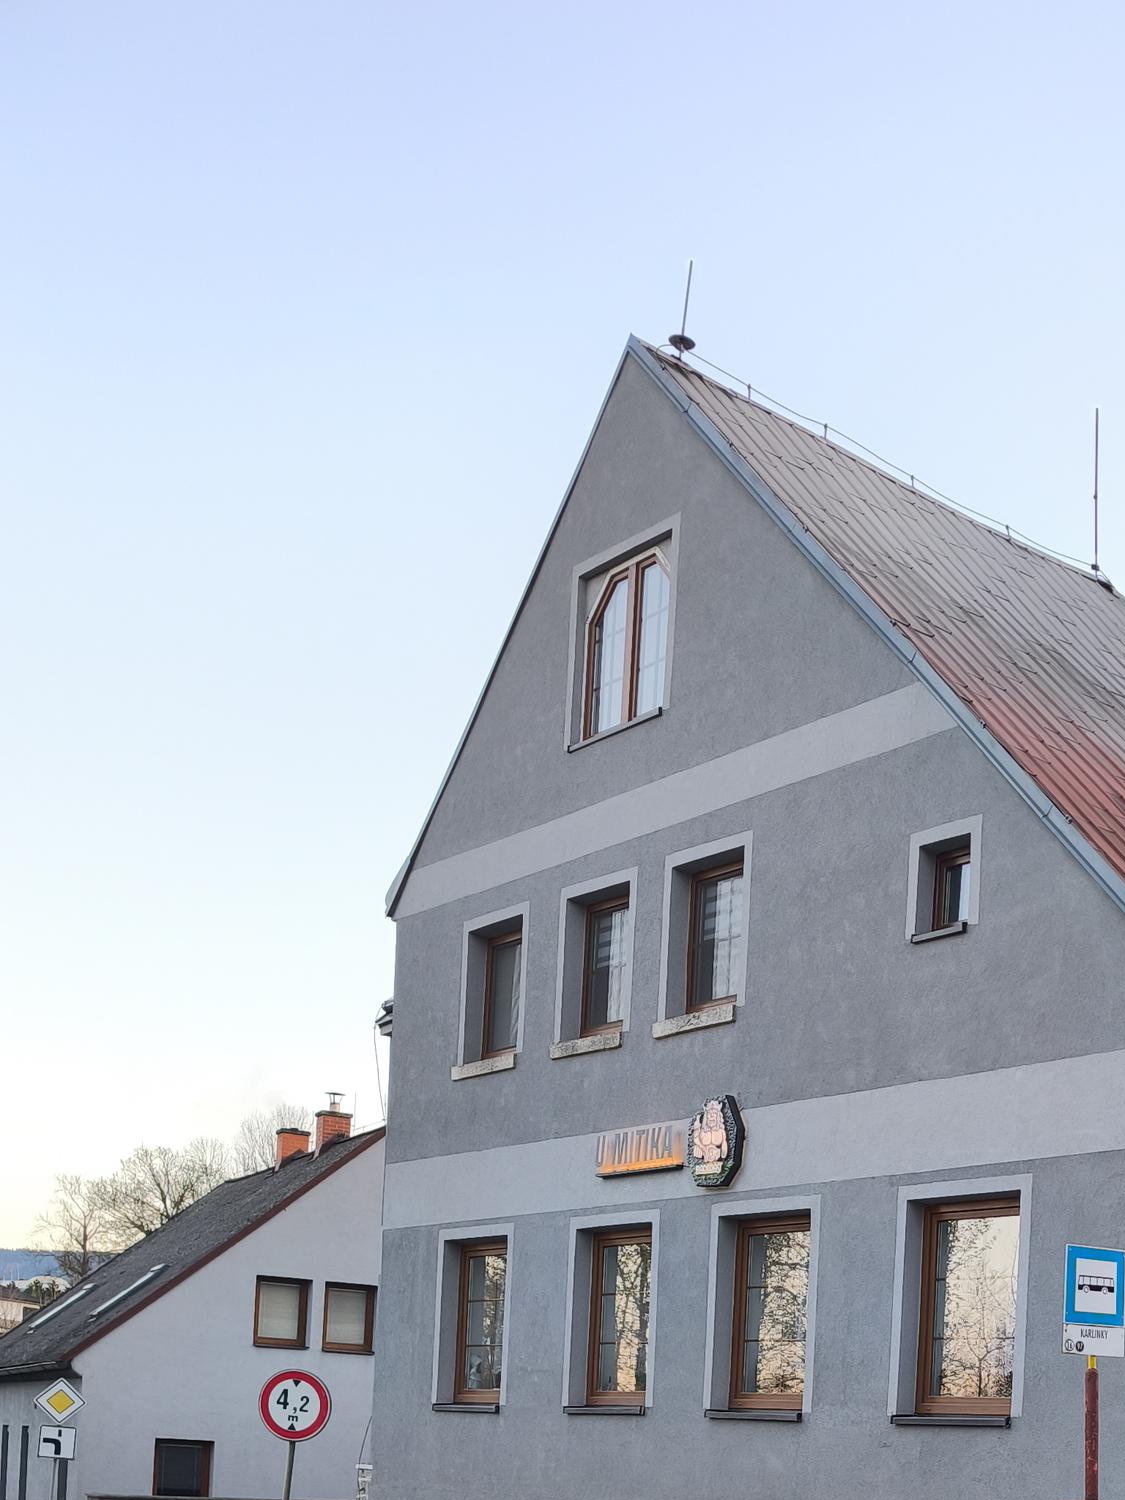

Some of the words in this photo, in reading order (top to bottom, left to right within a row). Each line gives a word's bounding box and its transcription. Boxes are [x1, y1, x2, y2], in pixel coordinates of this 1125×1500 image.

[596, 1135, 606, 1167] U
[613, 1125, 673, 1166] MITIKA
[1080, 1328, 1109, 1340] KARLINKY
[276, 1388, 310, 1414] 4,2
[287, 1414, 299, 1422] m
